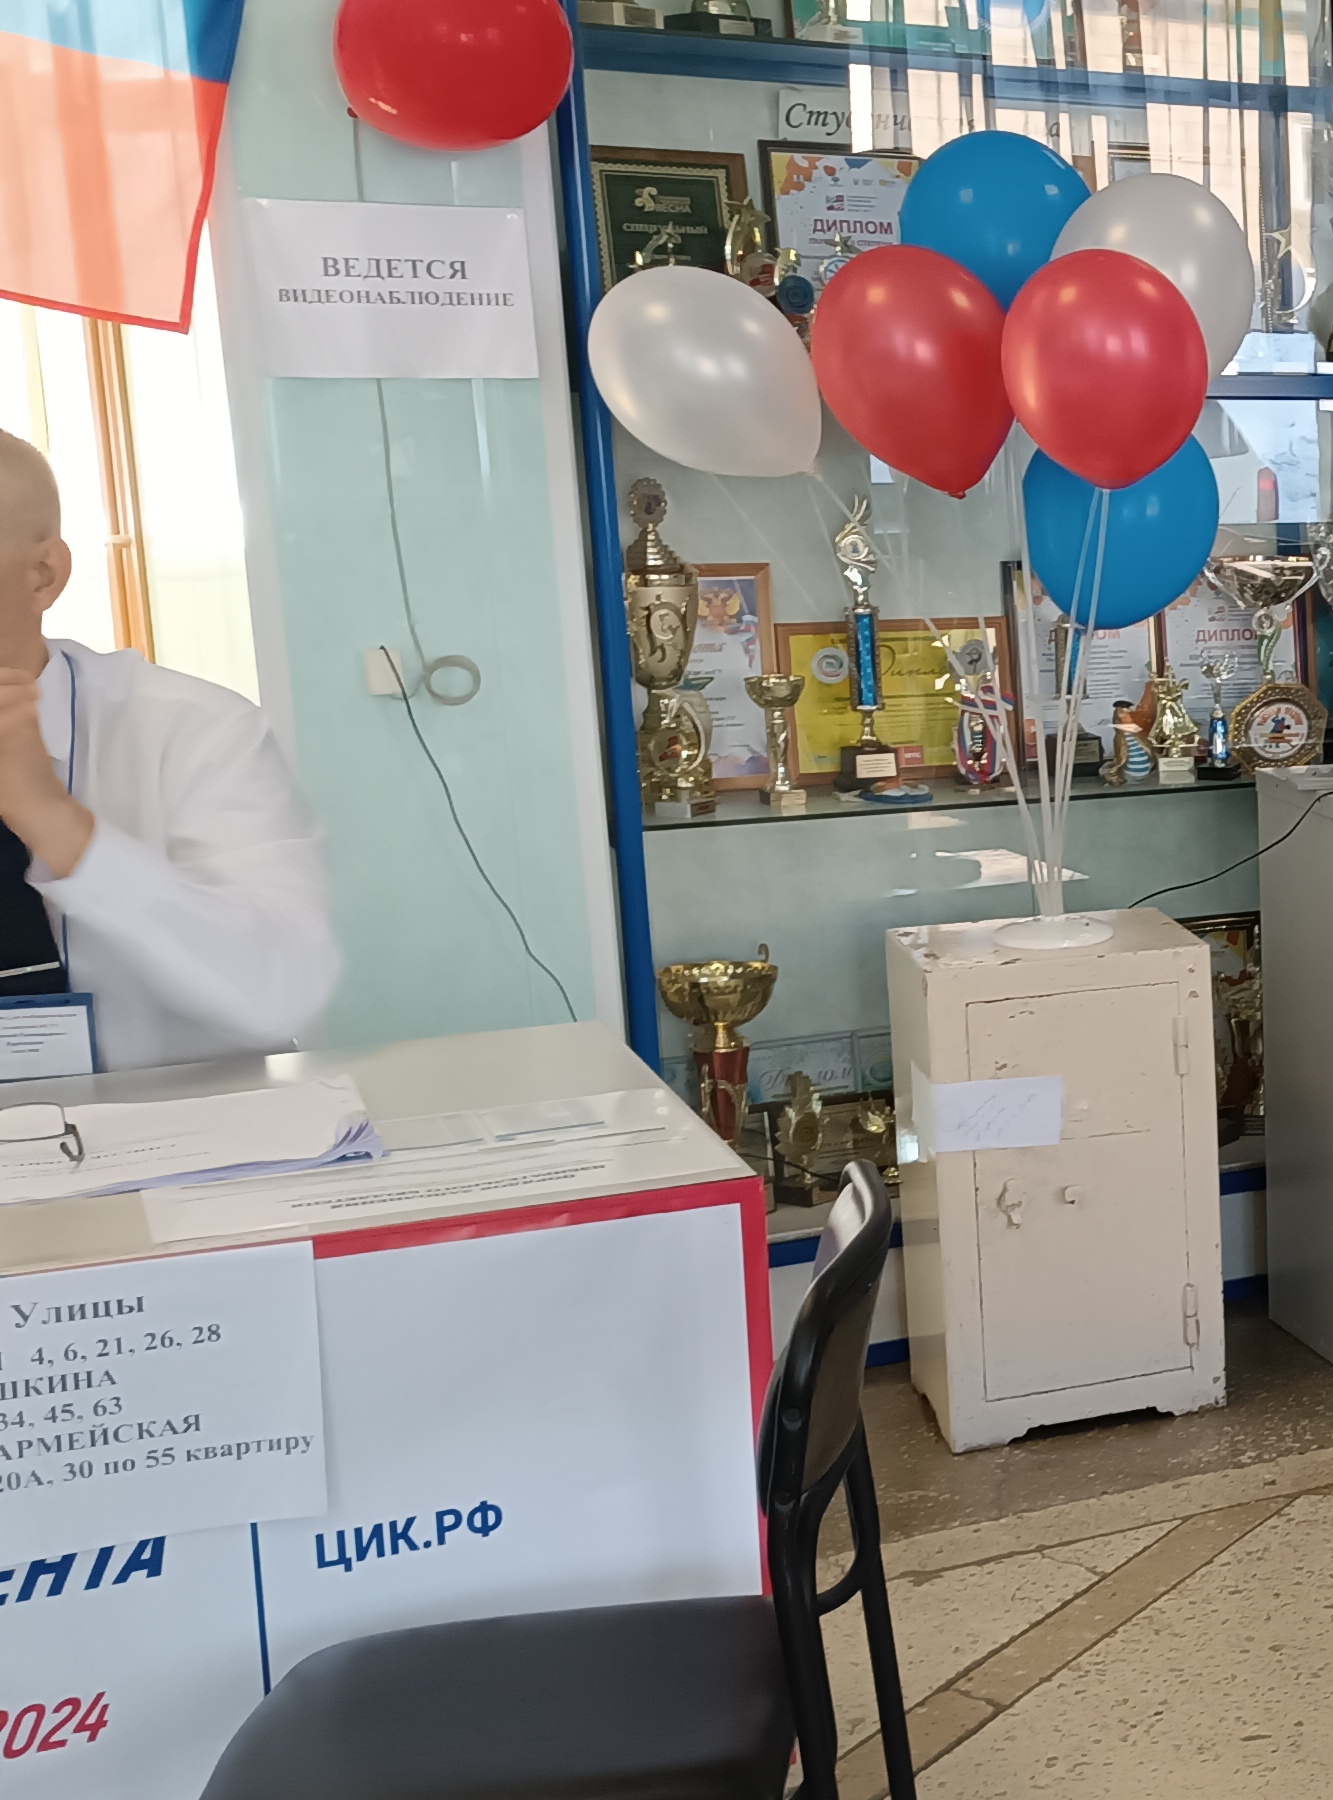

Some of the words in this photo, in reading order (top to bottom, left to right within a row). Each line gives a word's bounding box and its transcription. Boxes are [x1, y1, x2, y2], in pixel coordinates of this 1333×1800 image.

[812, 218, 893, 235] ДИПЛОМ
[321, 256, 469, 281] ВЕДЕТСЯ
[278, 288, 515, 307] ВИДЕОНАБЛЮДЕНИЕ
[1195, 629, 1258, 644] ДИПЛО
[9, 1296, 145, 1329] Улицы
[30, 1347, 55, 1368] 4,
[63, 1342, 88, 1363] 6,
[95, 1336, 136, 1358] 21,
[143, 1329, 183, 1351] 26,
[190, 1323, 222, 1346] 28
[43, 1402, 84, 1425] 45,
[92, 1396, 123, 1418] 63
[0, 1470, 54, 1493] 0А,
[62, 1460, 94, 1482] 30
[104, 1458, 136, 1476] по
[145, 1447, 176, 1469] 55
[186, 1435, 315, 1463] квартиру
[315, 1500, 503, 1573] ЦИК.РФ
